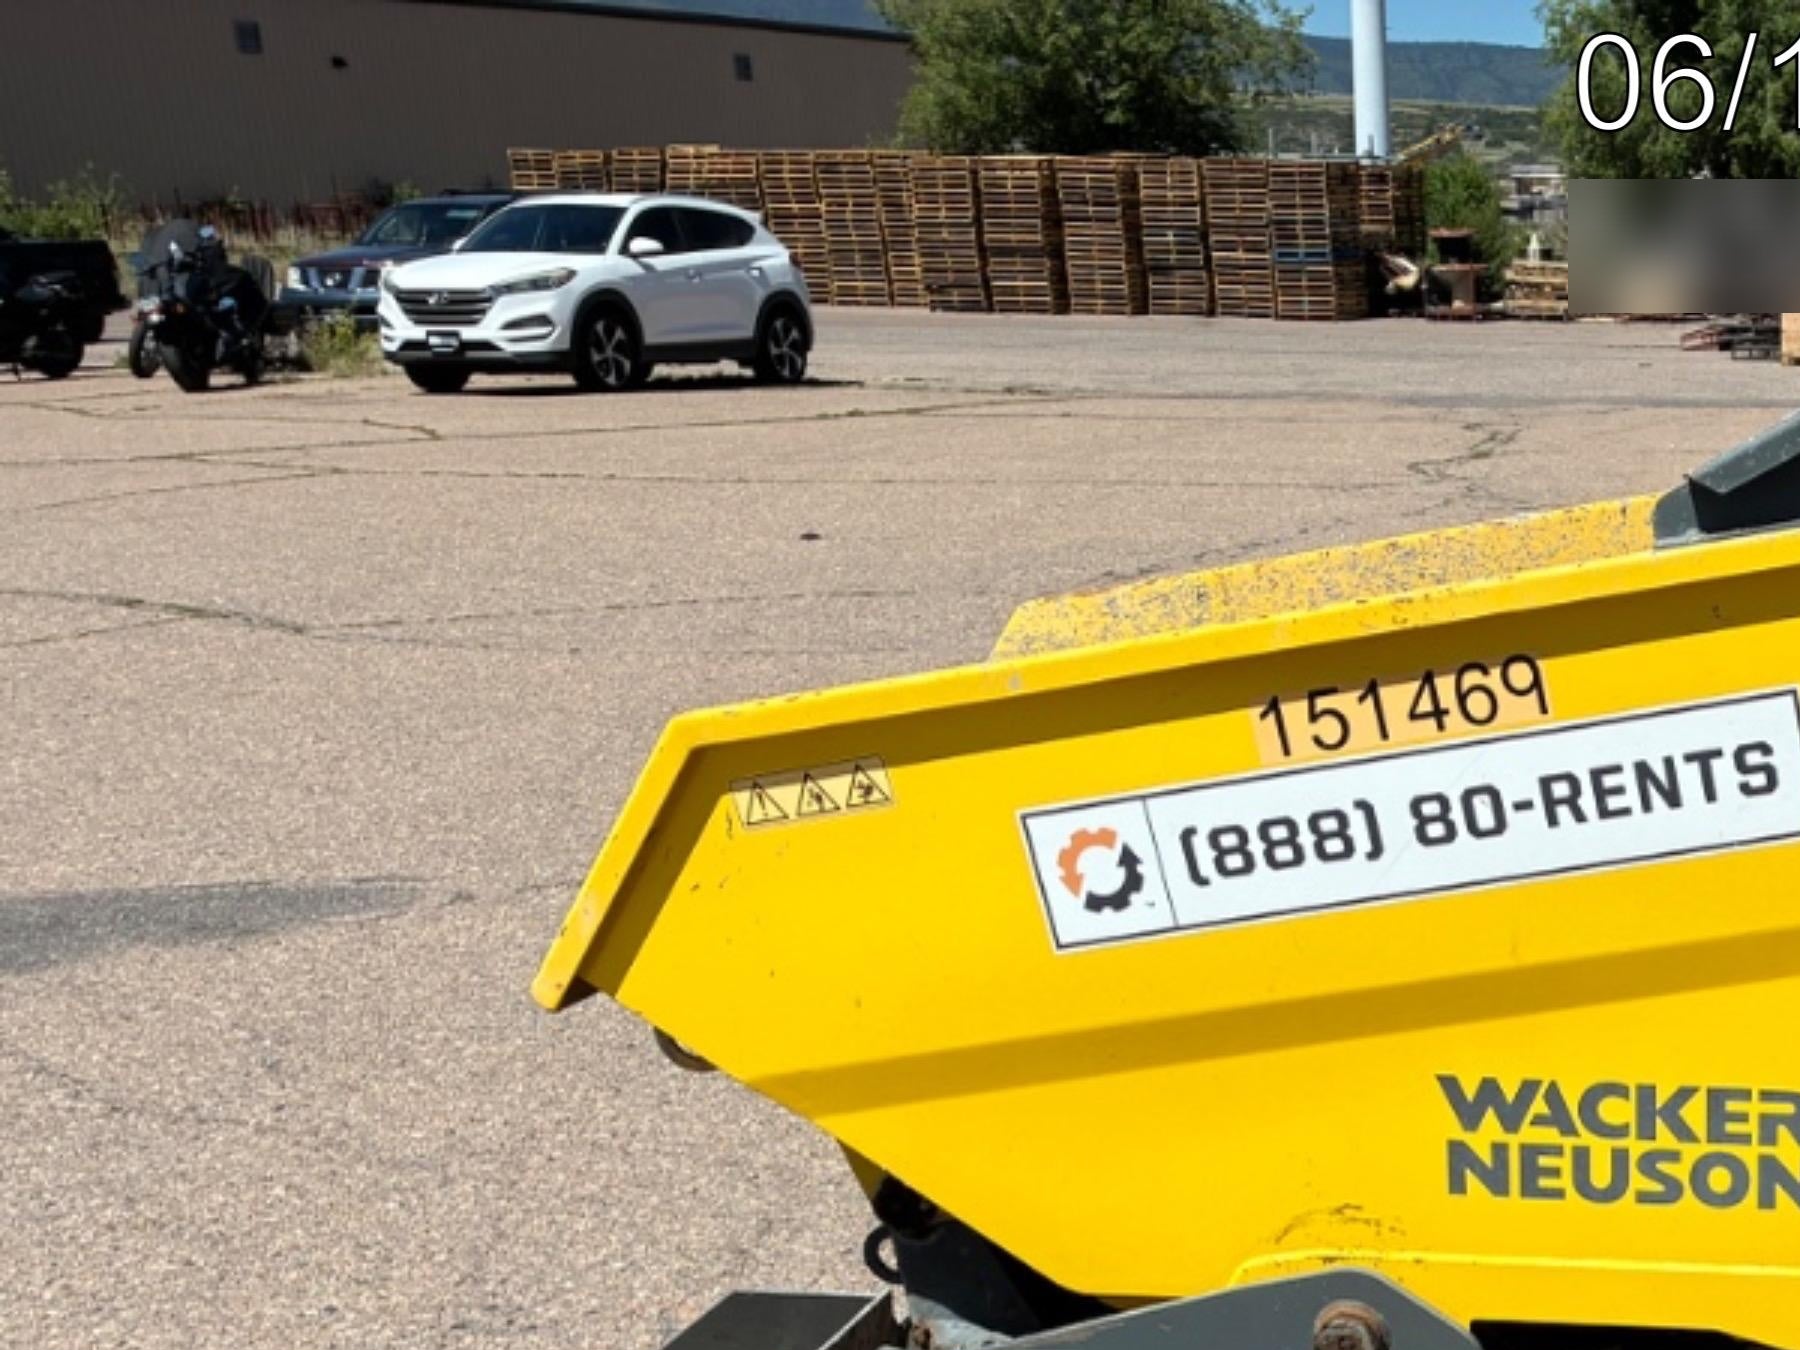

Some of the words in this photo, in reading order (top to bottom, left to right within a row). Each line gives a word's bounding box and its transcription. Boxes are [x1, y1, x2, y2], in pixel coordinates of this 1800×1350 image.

[1258, 653, 1551, 758] 151469
[1178, 799, 1385, 887] (888)
[1410, 739, 1780, 849] 80-RENTS
